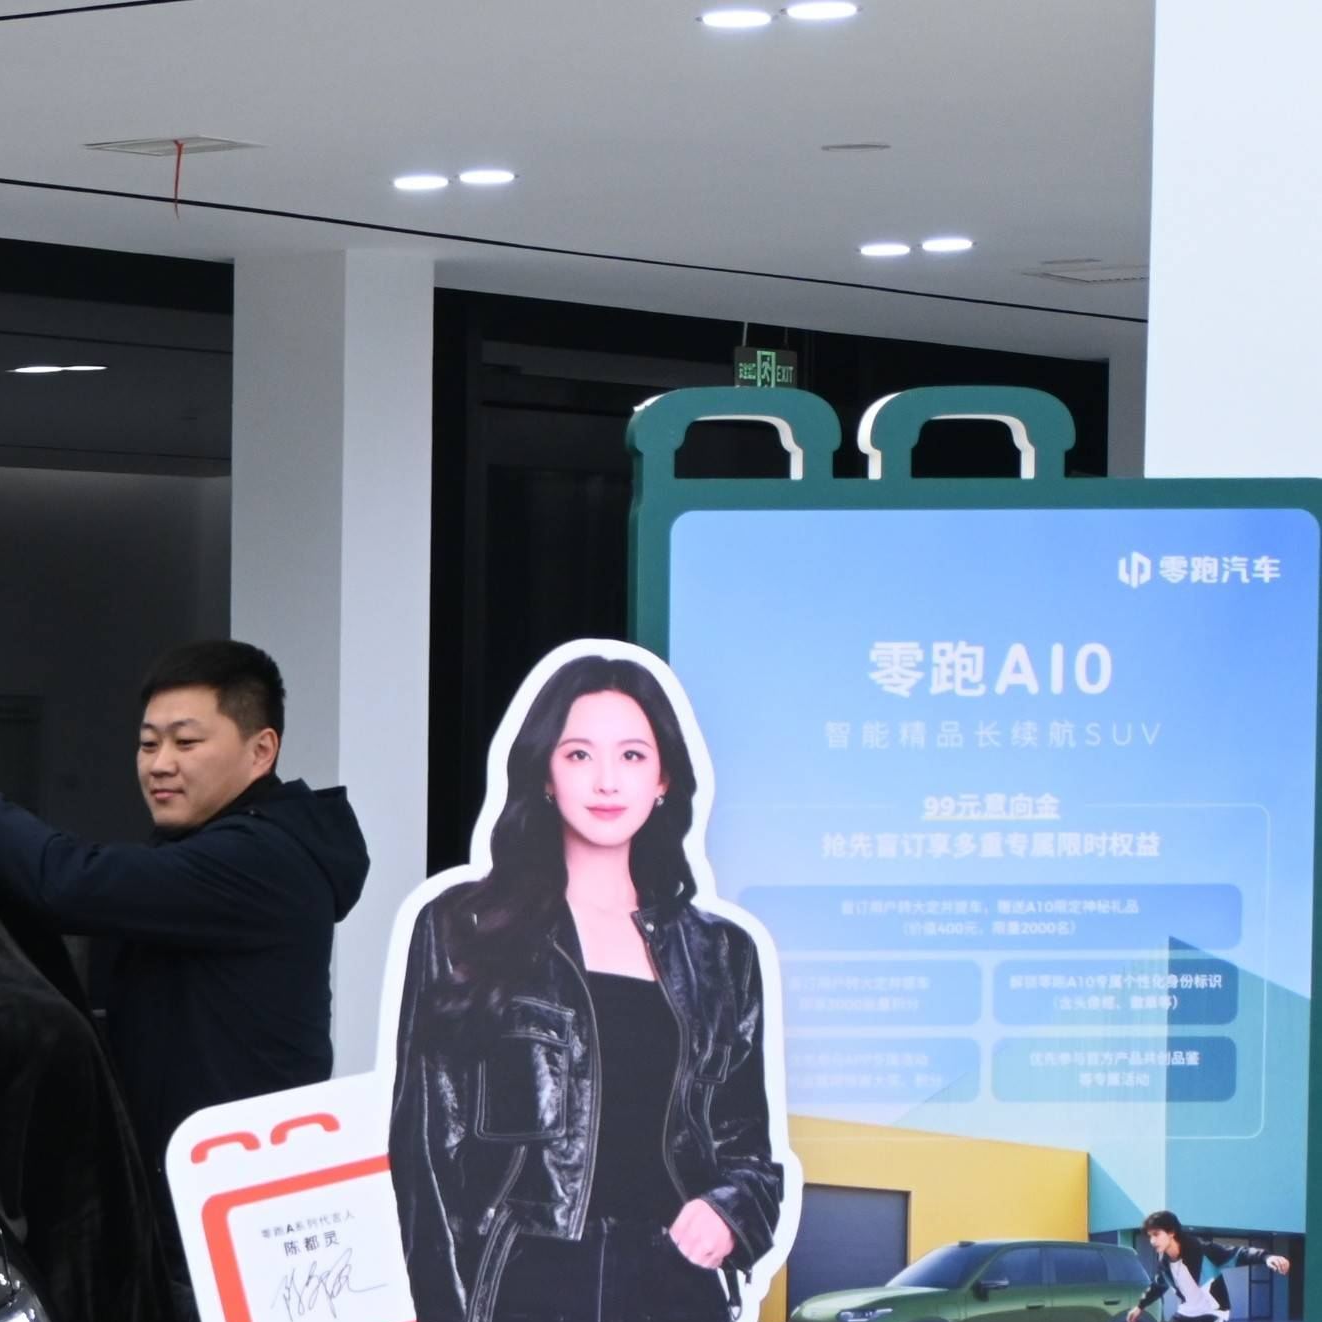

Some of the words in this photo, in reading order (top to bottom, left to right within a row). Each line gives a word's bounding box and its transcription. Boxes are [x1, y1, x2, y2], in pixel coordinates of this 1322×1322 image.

[777, 365, 794, 383] EXIT
[1159, 555, 1282, 584] 零跑汽车
[824, 720, 1161, 750] 智能精品长续航SUV
[923, 793, 1061, 817] 99元意向金
[821, 832, 1161, 858] 抢先盲订享多重专属限时权益
